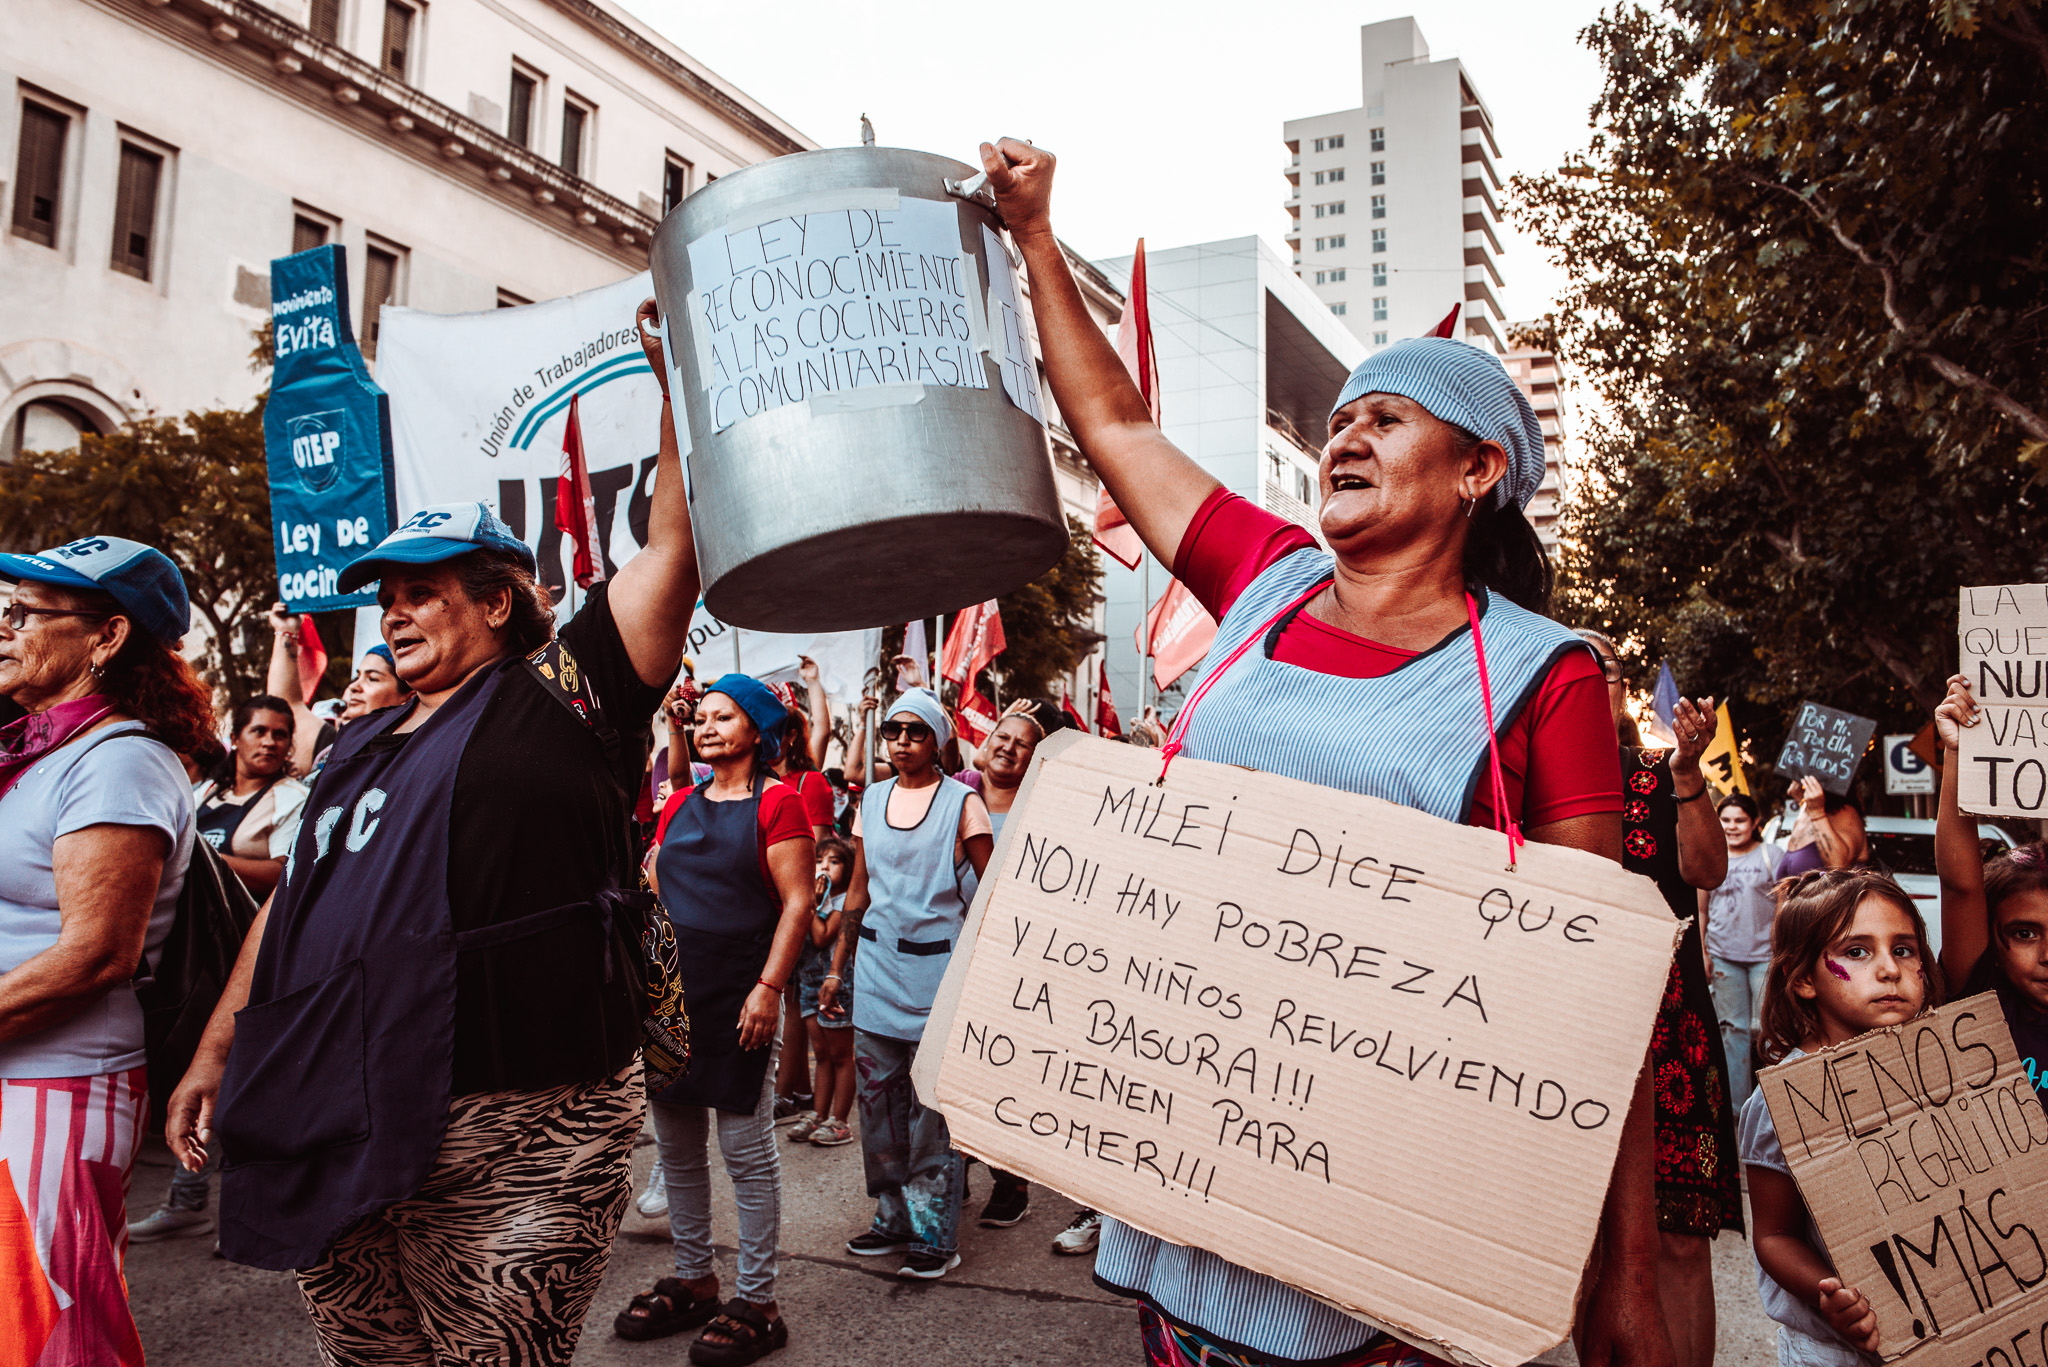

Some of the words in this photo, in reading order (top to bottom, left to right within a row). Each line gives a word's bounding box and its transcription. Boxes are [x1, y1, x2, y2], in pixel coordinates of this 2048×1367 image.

[725, 214, 807, 276] LEY
[847, 209, 902, 249] DE
[480, 405, 515, 458] Unión
[512, 384, 535, 408] de
[534, 326, 640, 388] Trabajadores
[731, 317, 789, 373] LAS
[796, 294, 970, 349] COCINERAS
[1965, 627, 2047, 657] QUE
[1969, 587, 2021, 616] LA
[1980, 661, 2048, 698] NU
[1902, 745, 1918, 769] E
[1014, 832, 1100, 904] NO!!
[1117, 874, 1182, 929] HAY
[1214, 902, 1490, 1024] POBREZA
[1092, 783, 1237, 856] MILEI
[1277, 828, 1426, 904] DICE
[1477, 888, 1598, 944] QUE
[1010, 917, 1032, 958] Y
[1043, 928, 1109, 974] LOS
[1124, 957, 1244, 1021] NIÑOS
[1269, 999, 1611, 1131] REVOLVIENDO
[1012, 978, 1053, 1025] LA
[1087, 999, 1315, 1112] BASURA!!!
[1783, 1012, 1998, 1158] MENOS
[962, 1021, 1016, 1067] NO
[1031, 1049, 1174, 1126] TIENEN
[1212, 1099, 1332, 1184] PARA
[994, 1096, 1217, 1204] COMER!!!
[1856, 1077, 2048, 1216] REGALITOS
